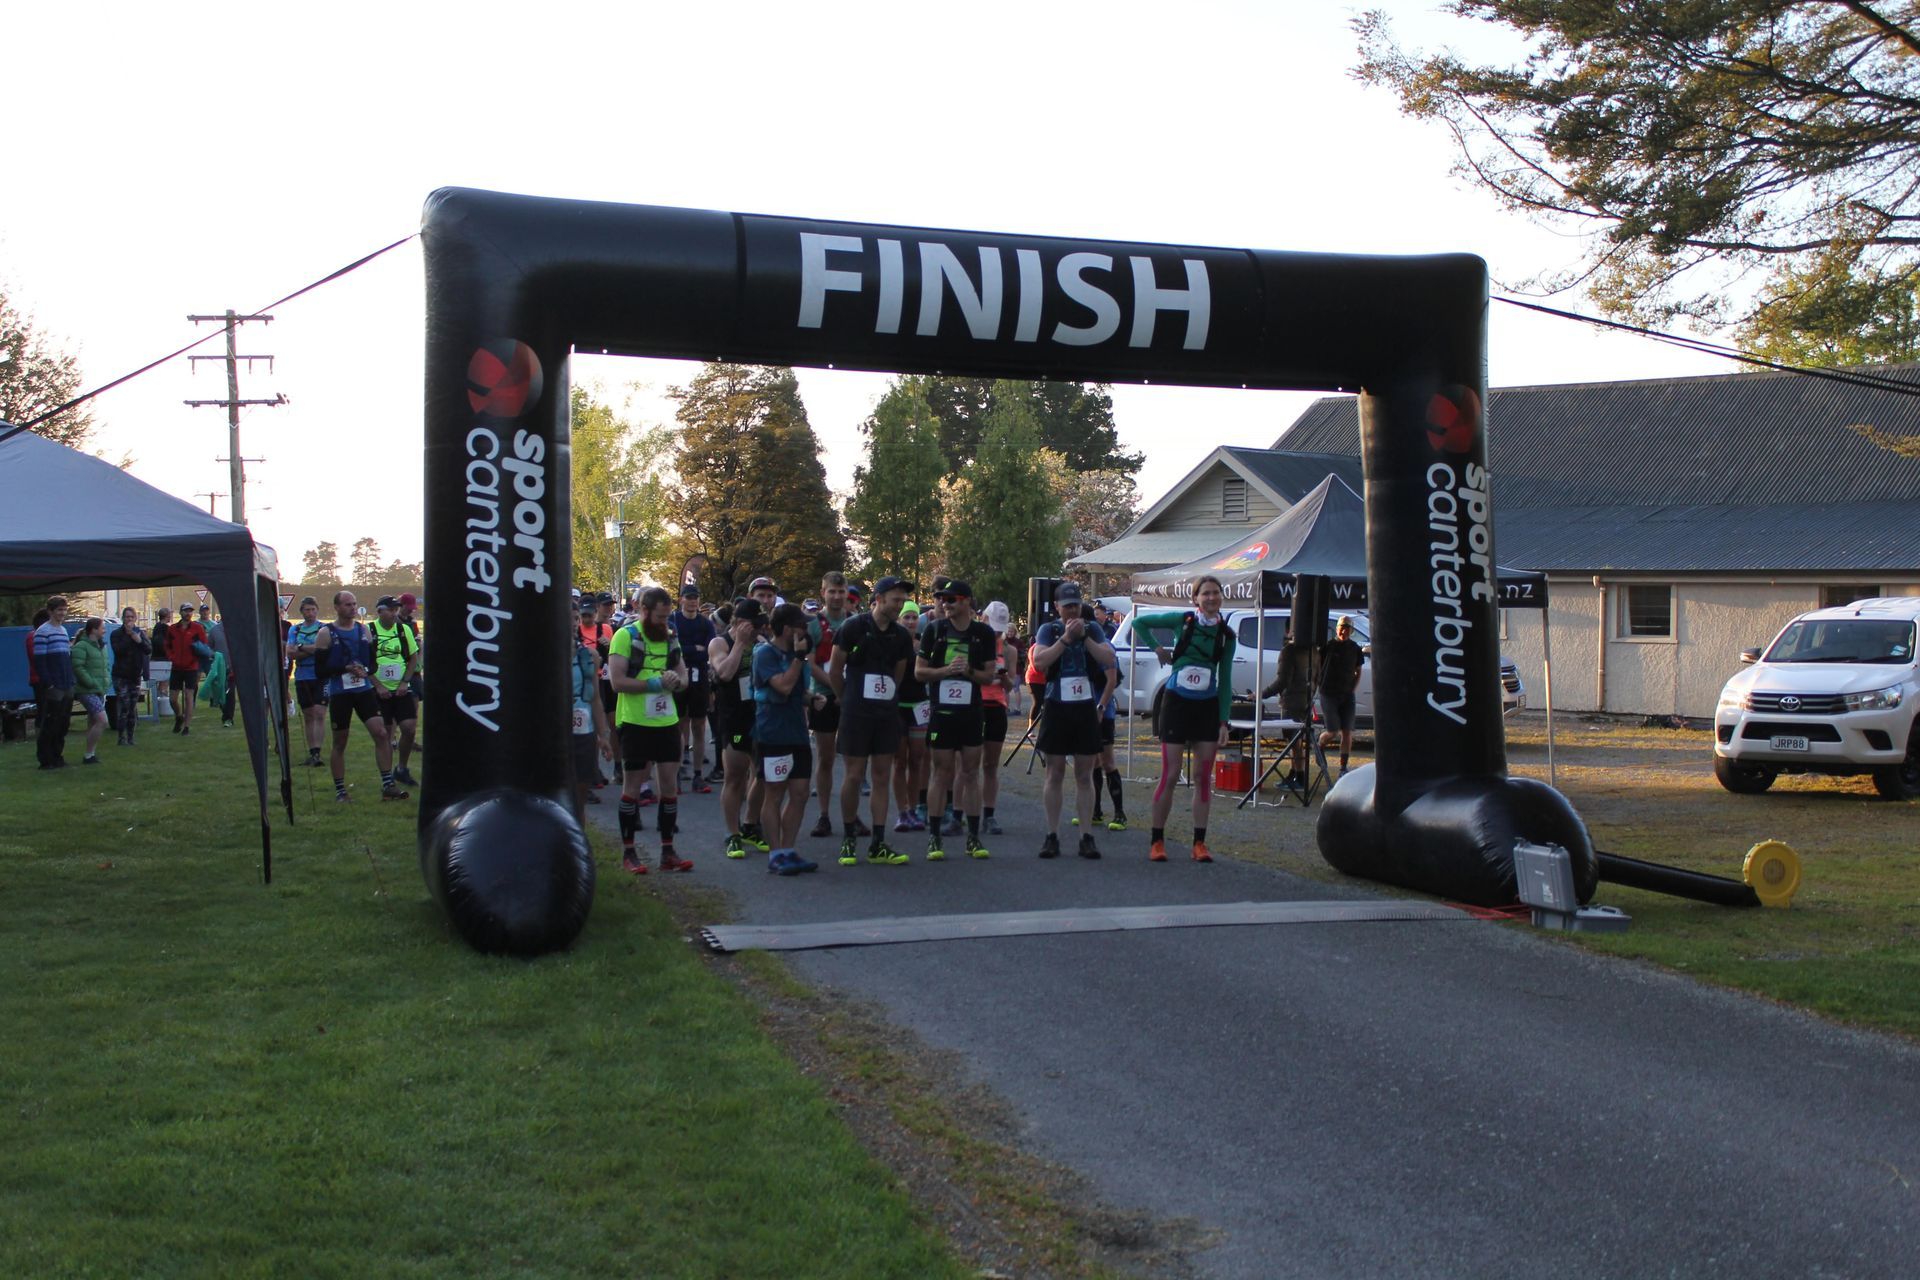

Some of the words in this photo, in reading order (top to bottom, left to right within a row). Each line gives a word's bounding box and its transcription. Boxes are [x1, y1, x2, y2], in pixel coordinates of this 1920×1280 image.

[798, 232, 1211, 350] FINISH
[501, 429, 551, 593] sport
[1458, 462, 1494, 603] sport
[456, 427, 512, 732] canterbury
[1426, 462, 1472, 725] canterbury
[385, 669, 394, 677] 31
[1186, 674, 1200, 684] 40
[874, 682, 887, 693] 55
[948, 688, 962, 698] 22
[1071, 684, 1082, 695] 14
[655, 701, 666, 711] 54
[1775, 739, 1805, 749] JRP88
[774, 764, 788, 776] 66
